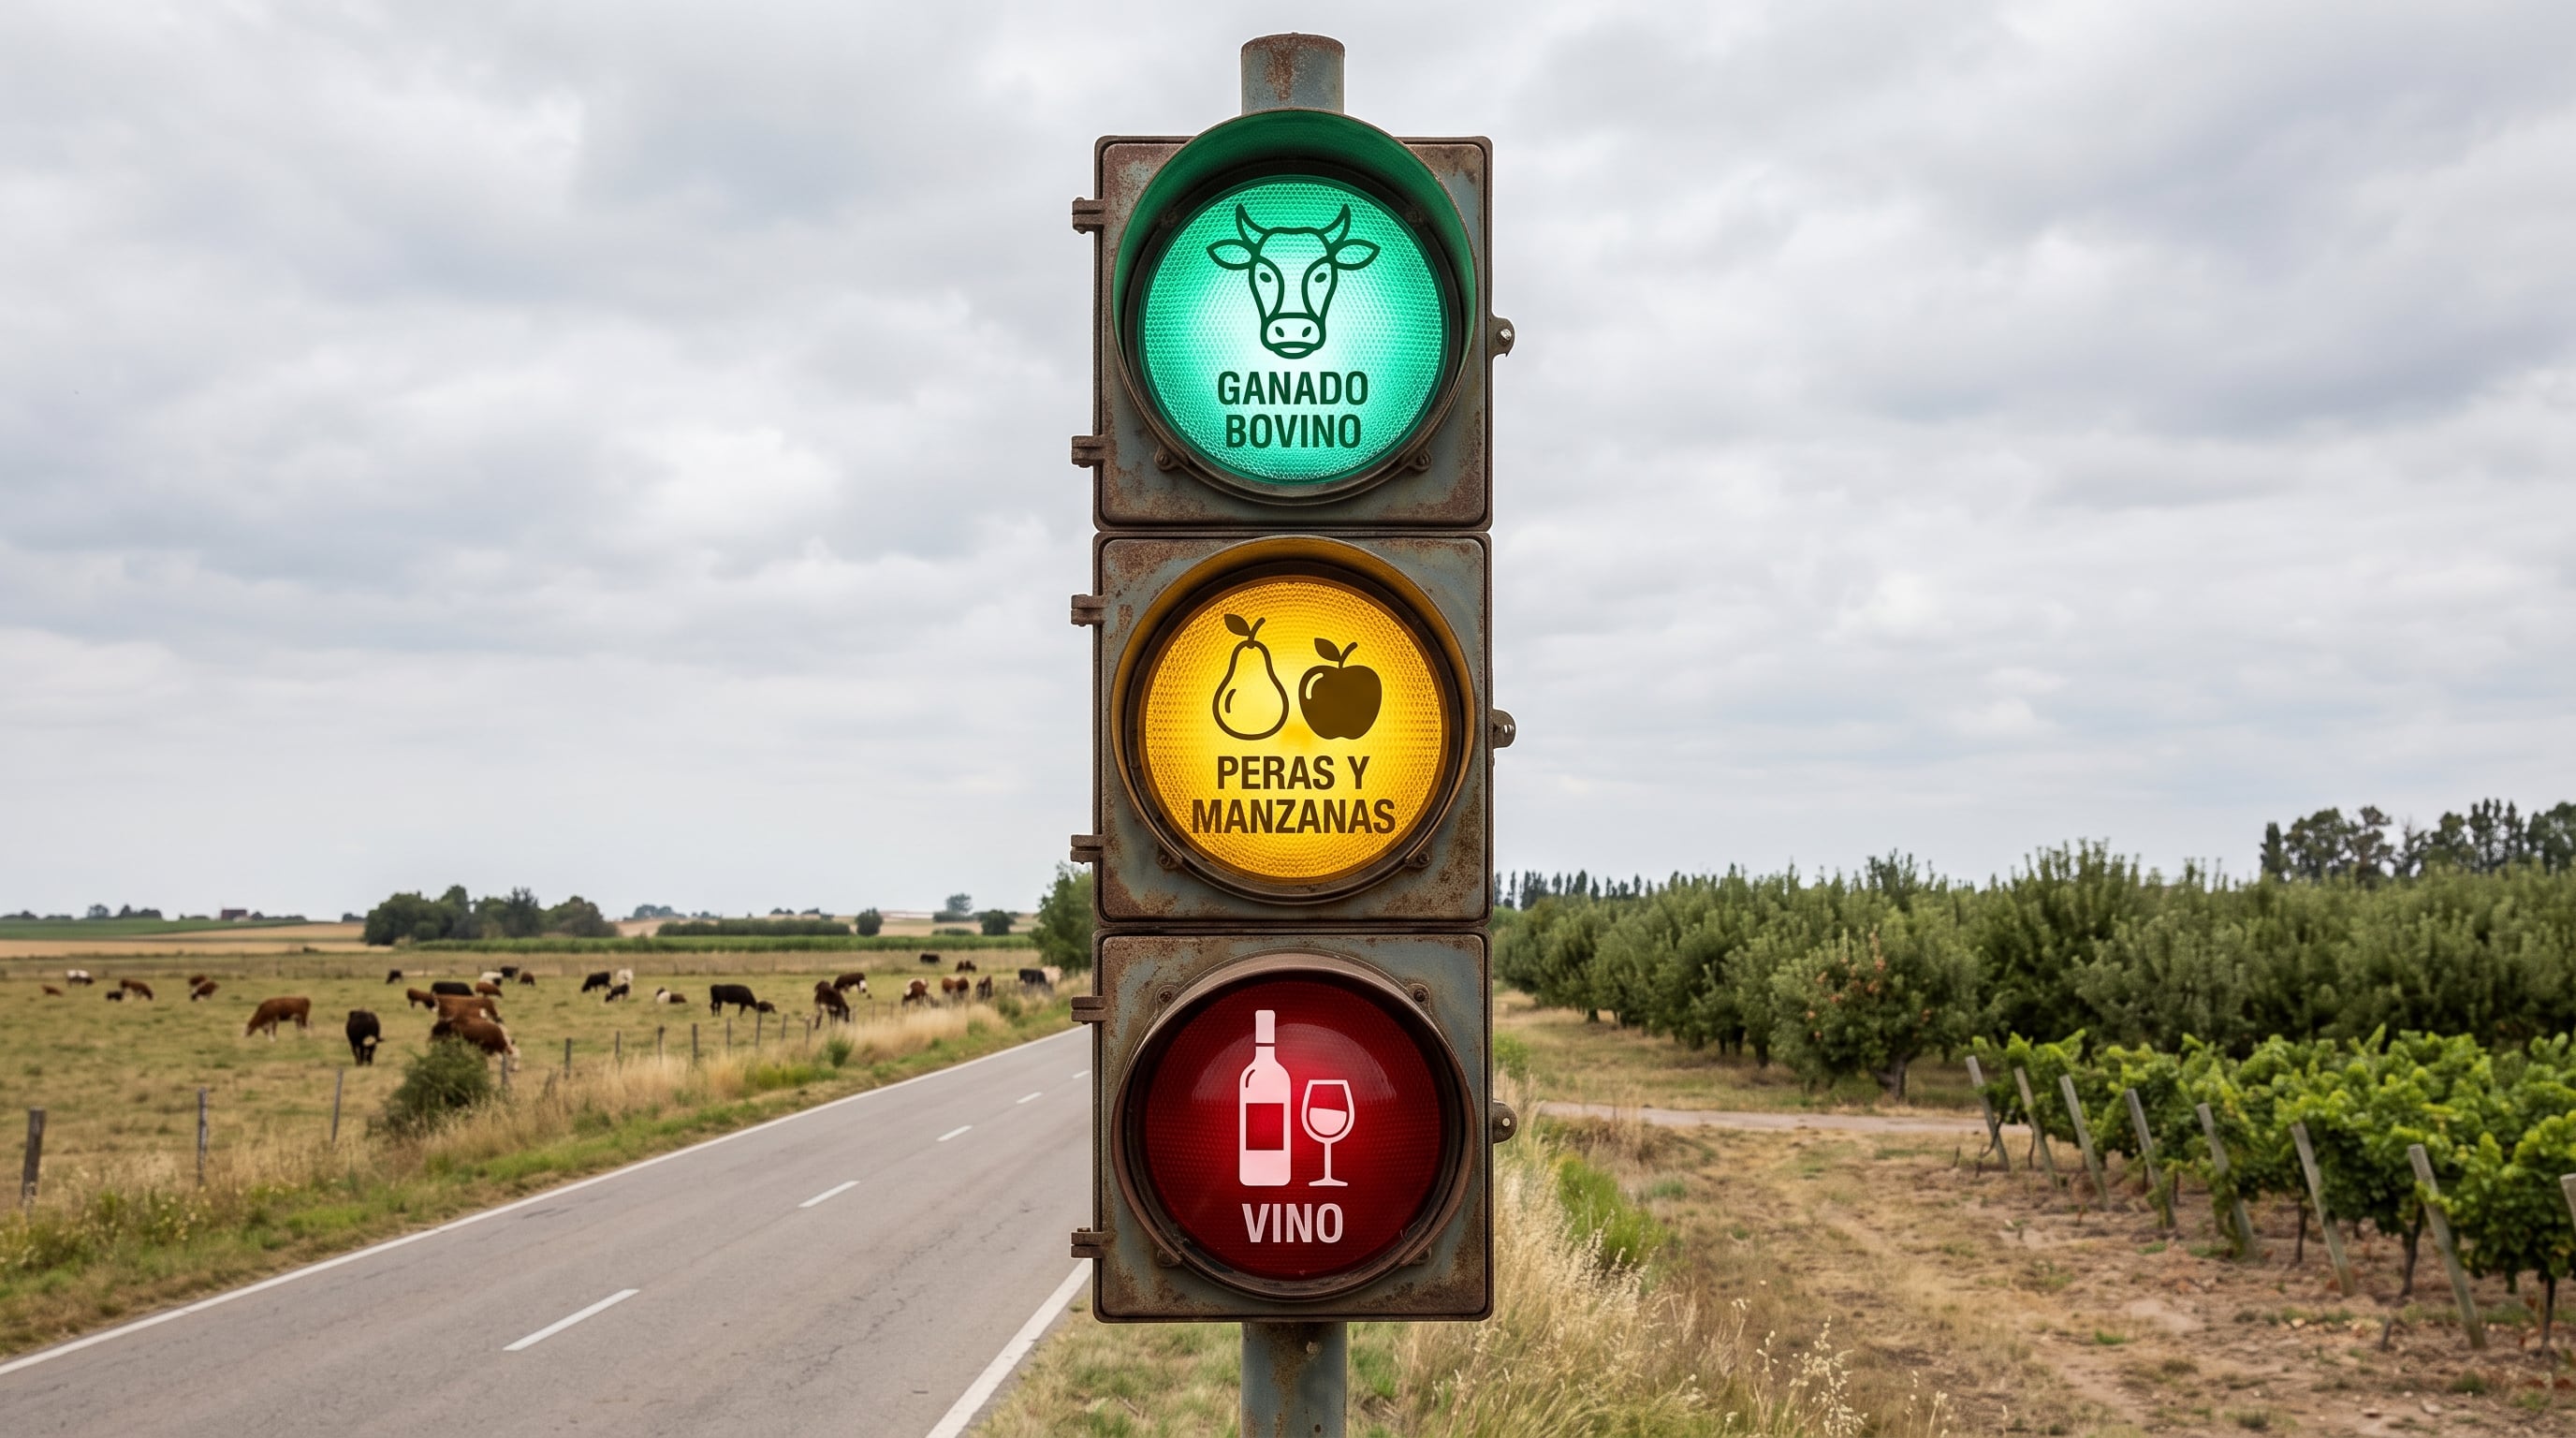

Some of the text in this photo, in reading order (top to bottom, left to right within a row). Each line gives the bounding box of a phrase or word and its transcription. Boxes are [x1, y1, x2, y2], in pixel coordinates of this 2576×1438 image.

[1217, 371, 1368, 405] GANADO
[1225, 414, 1362, 448] BOVINO
[1217, 756, 1370, 790] PERAS Y
[1192, 799, 1397, 834] MANZANAS
[1241, 1203, 1343, 1243] VINO
